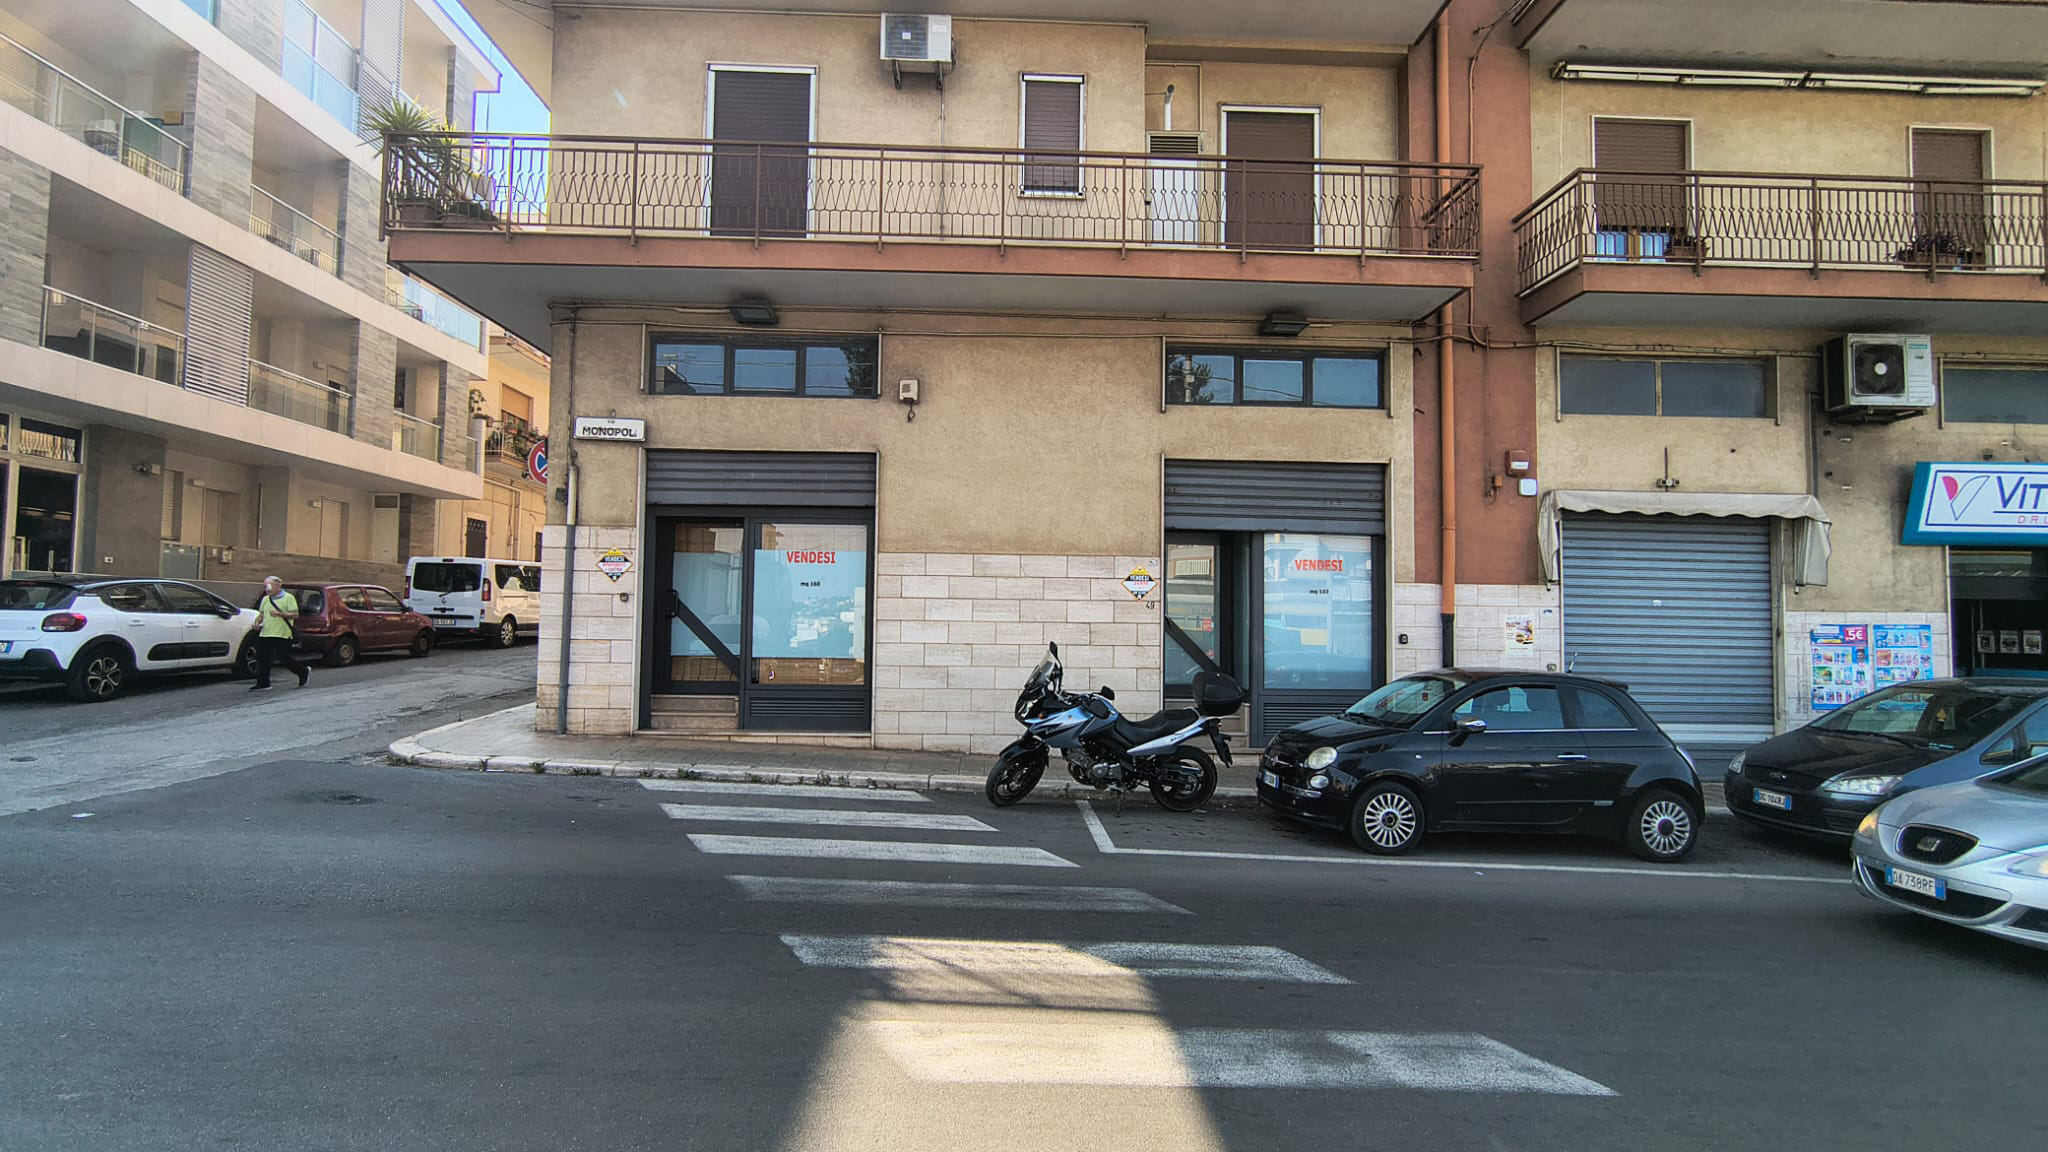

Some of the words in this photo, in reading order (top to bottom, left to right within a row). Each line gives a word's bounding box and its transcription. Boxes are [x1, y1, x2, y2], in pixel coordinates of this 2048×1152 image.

[786, 551, 836, 564] VENDESI
[1294, 559, 1343, 572] VENDESI
[1145, 601, 1155, 609] 49
